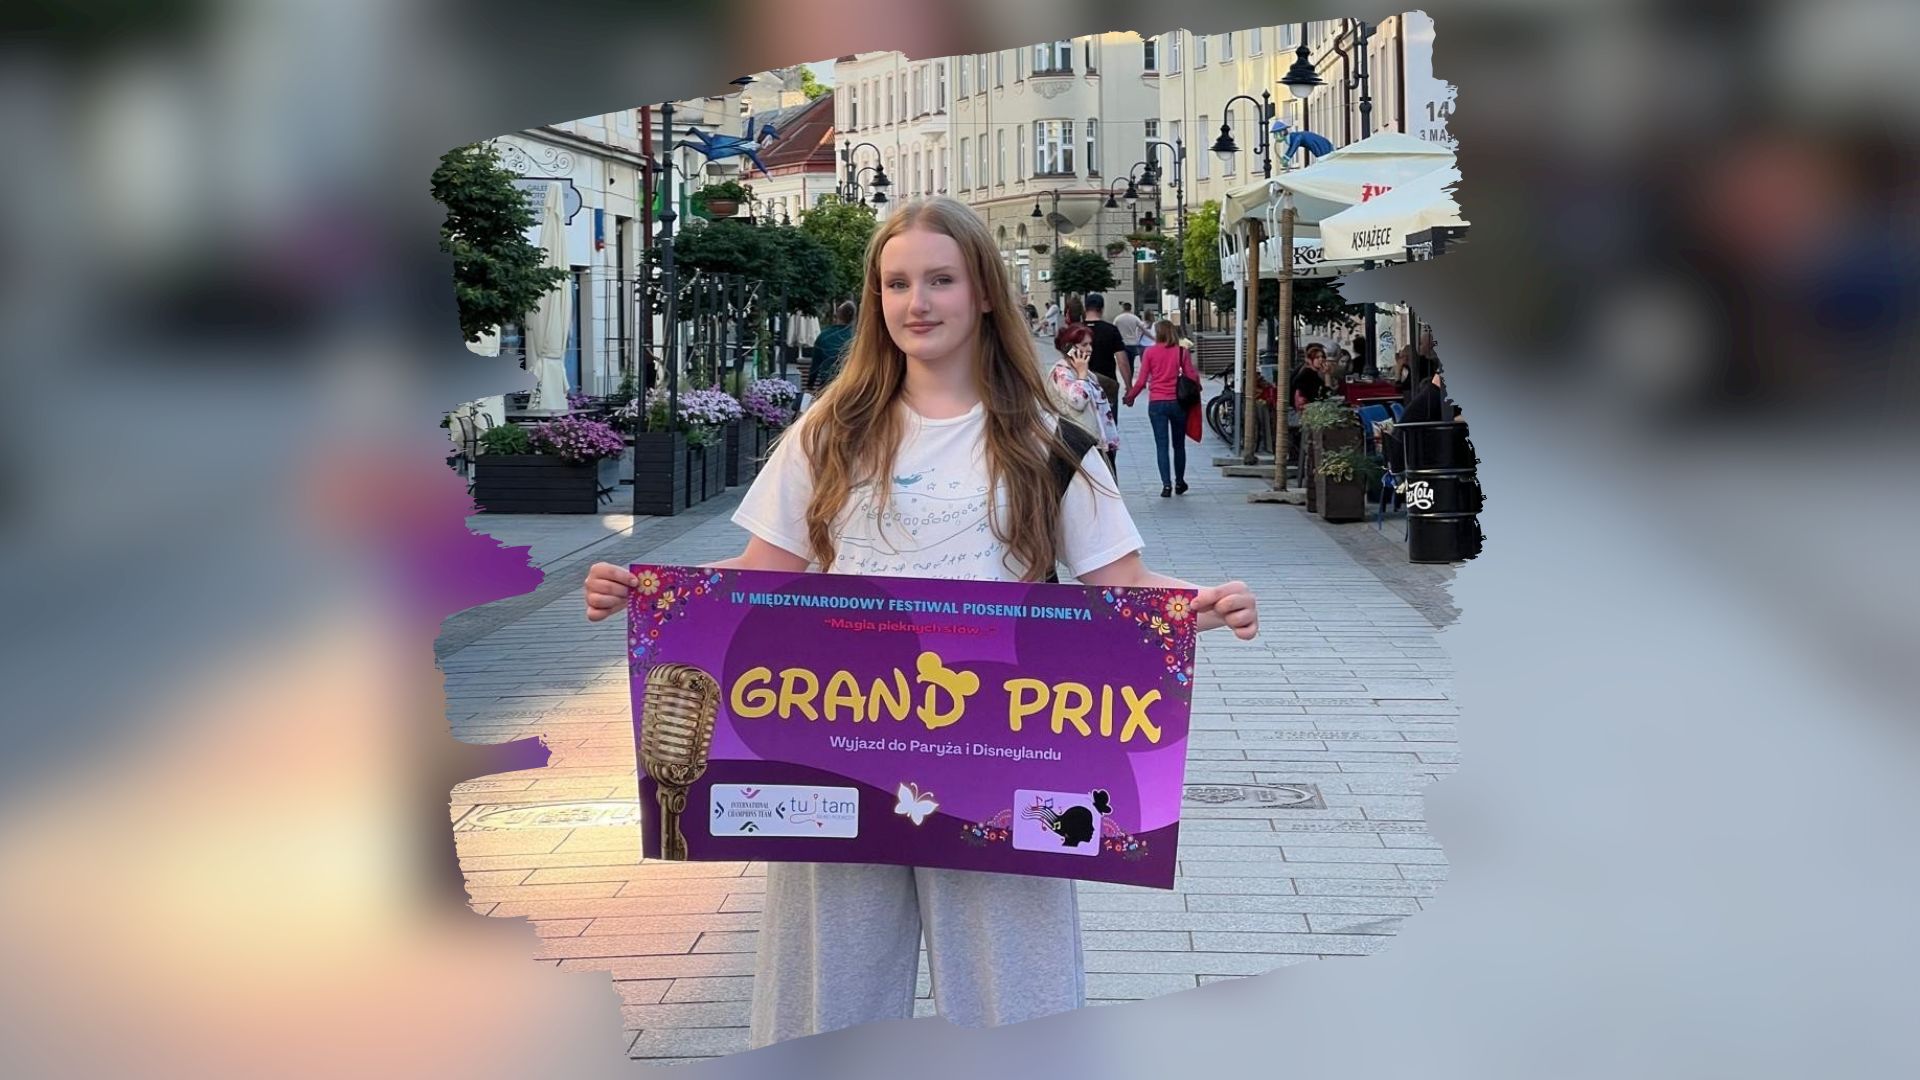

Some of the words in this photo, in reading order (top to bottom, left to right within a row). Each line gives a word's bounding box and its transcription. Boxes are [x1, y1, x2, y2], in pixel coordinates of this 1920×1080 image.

[1351, 225, 1392, 251] KSIĄŻĘCE
[731, 592, 745, 603] IV
[749, 593, 885, 610] MIĘDZYNARODOWY
[888, 600, 958, 614] FESTIWAL
[963, 603, 1027, 617] PIOSENKI
[1031, 606, 1092, 621] DISNEYA
[730, 651, 980, 730] GRAND
[1003, 678, 1162, 744] PRIX
[829, 735, 885, 752] Wyjazd
[888, 738, 907, 751] do
[910, 739, 962, 757] Paryża
[965, 743, 970, 755] i
[973, 743, 1062, 761] Disneylandu
[822, 798, 856, 813] tam
